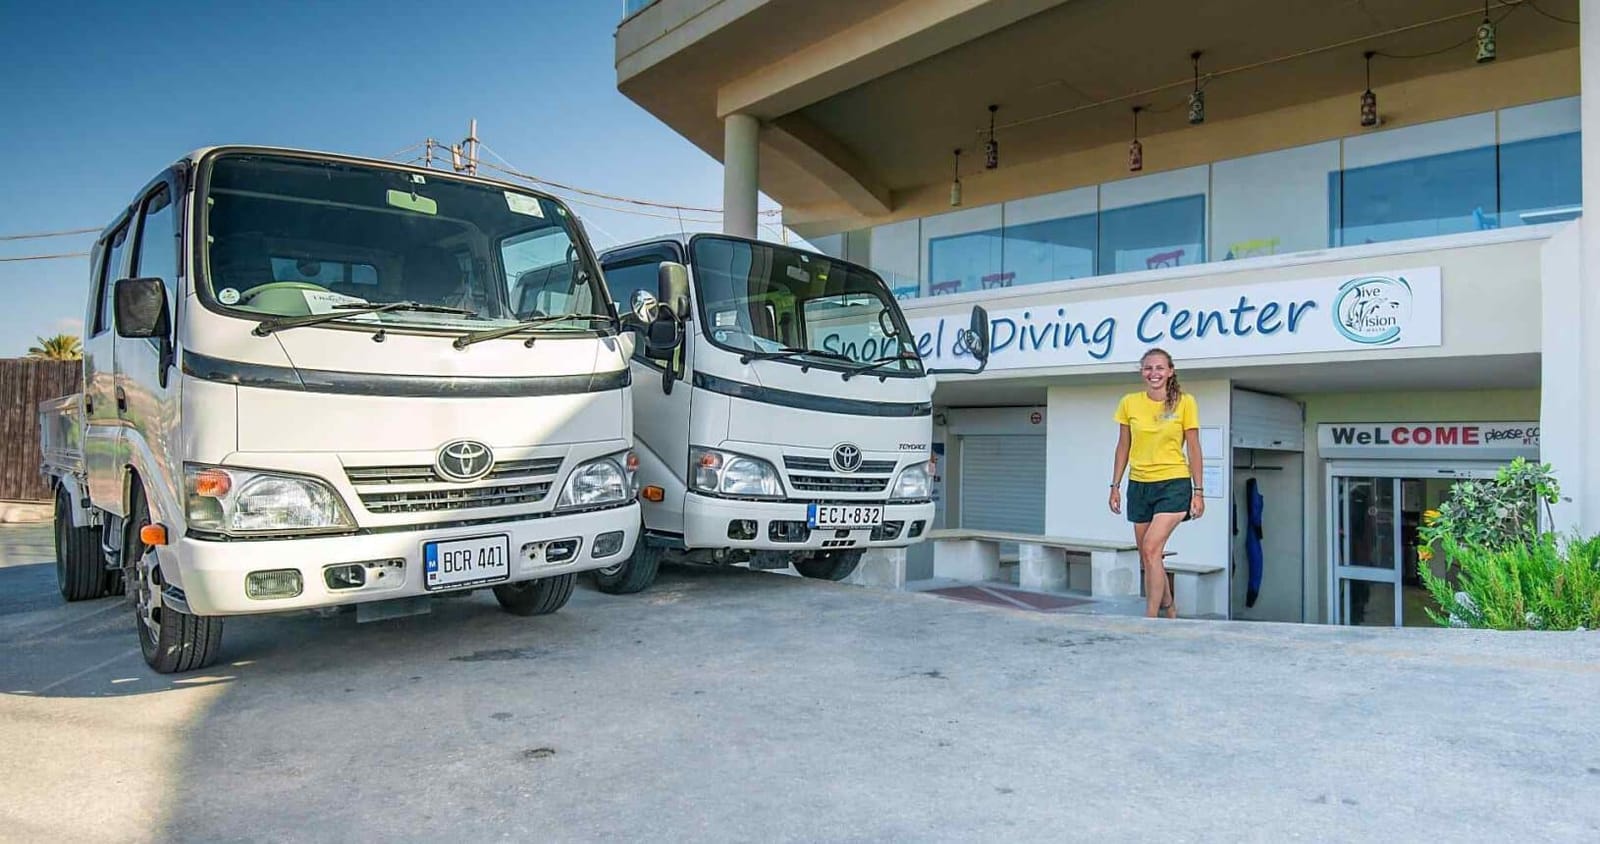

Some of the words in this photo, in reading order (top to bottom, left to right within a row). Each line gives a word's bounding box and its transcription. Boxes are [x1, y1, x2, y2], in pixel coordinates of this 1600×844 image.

[822, 319, 944, 362] Snorel
[990, 308, 1116, 359] Diving
[1136, 296, 1316, 343] Center
[443, 550, 472, 573] BCR
[478, 546, 504, 569] 441
